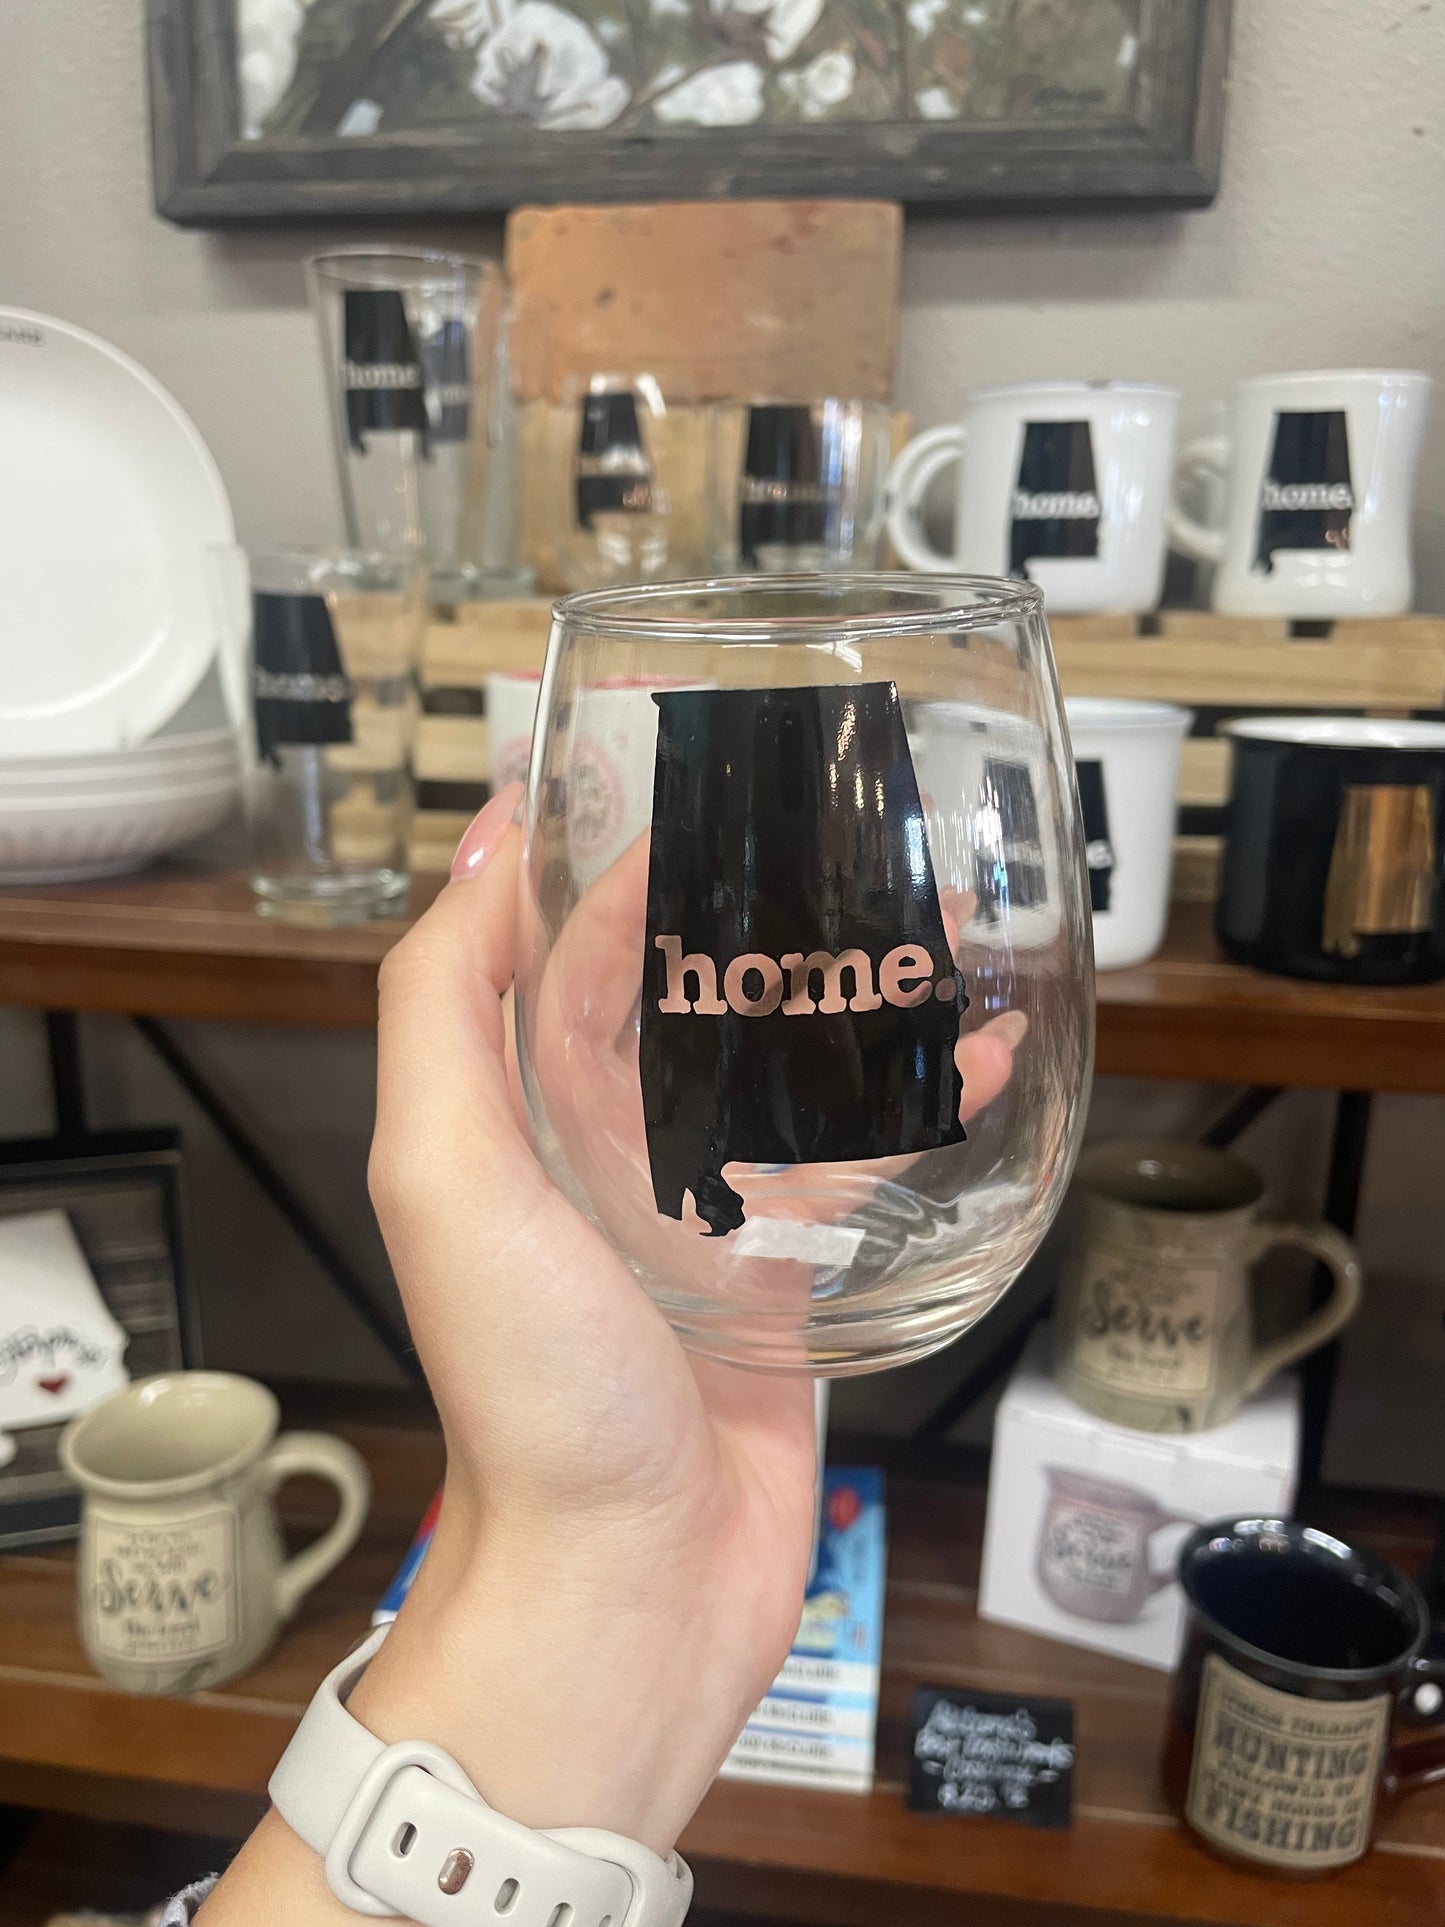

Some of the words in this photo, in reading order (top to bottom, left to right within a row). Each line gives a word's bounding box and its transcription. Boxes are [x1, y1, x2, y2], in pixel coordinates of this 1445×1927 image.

[654, 934, 958, 1017] home.
[1214, 1710, 1370, 1780] HUNTING
[1204, 1783, 1360, 1851] FISHING
